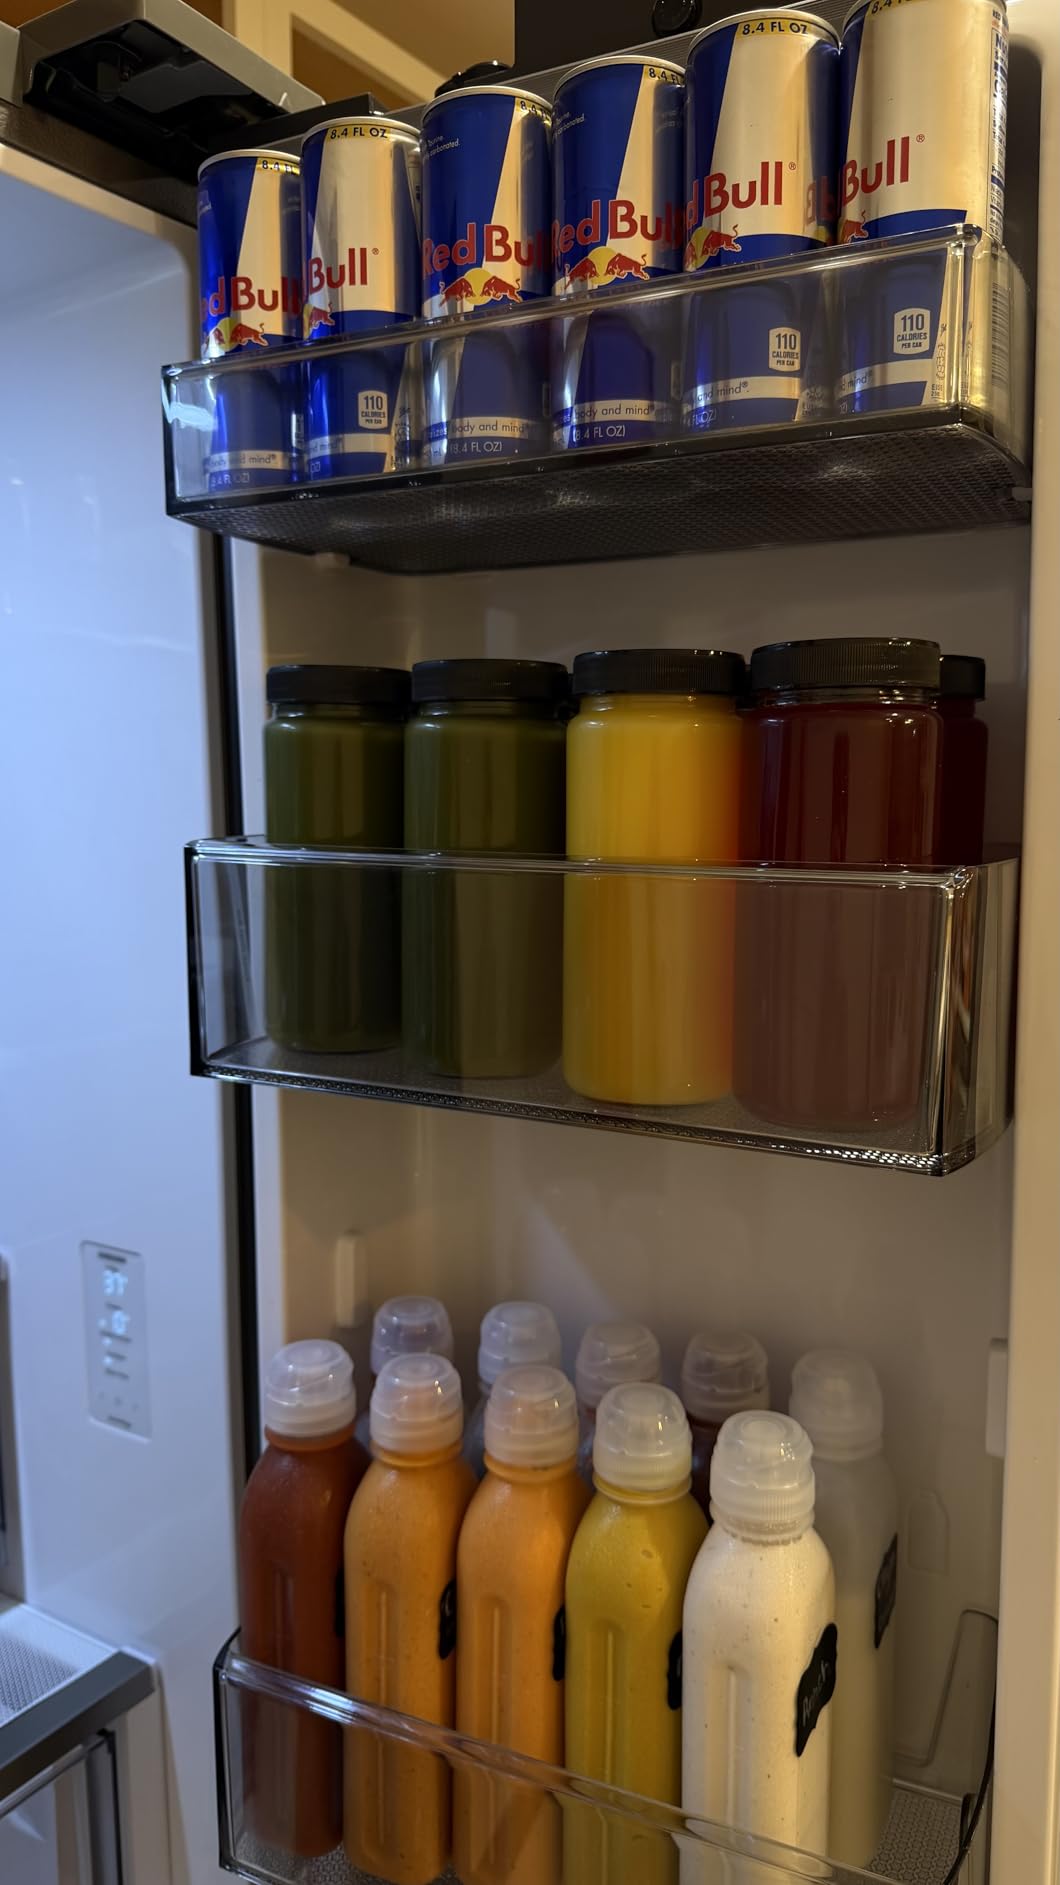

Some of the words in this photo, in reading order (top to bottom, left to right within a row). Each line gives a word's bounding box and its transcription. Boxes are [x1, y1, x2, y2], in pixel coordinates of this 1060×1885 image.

[741, 22, 765, 36] 8.4
[770, 21, 786, 33] FL
[790, 22, 809, 35] OZ
[649, 67, 667, 81] 8.4
[329, 127, 349, 140] 8.4
[353, 127, 365, 137] FL
[369, 127, 389, 139] OZ
[261, 159, 281, 172] 8.4
[900, 313, 925, 332] 110
[775, 333, 797, 350] 110
[896, 332, 928, 342] CALORIES
[772, 351, 799, 360] CALORIES
[363, 395, 383, 411] 110
[360, 411, 387, 419] CALORIES
[601, 404, 621, 416] and
[479, 420, 498, 432] and
[594, 427, 604, 438] FL
[606, 425, 626, 438] OZ)
[471, 442, 481, 453] FL
